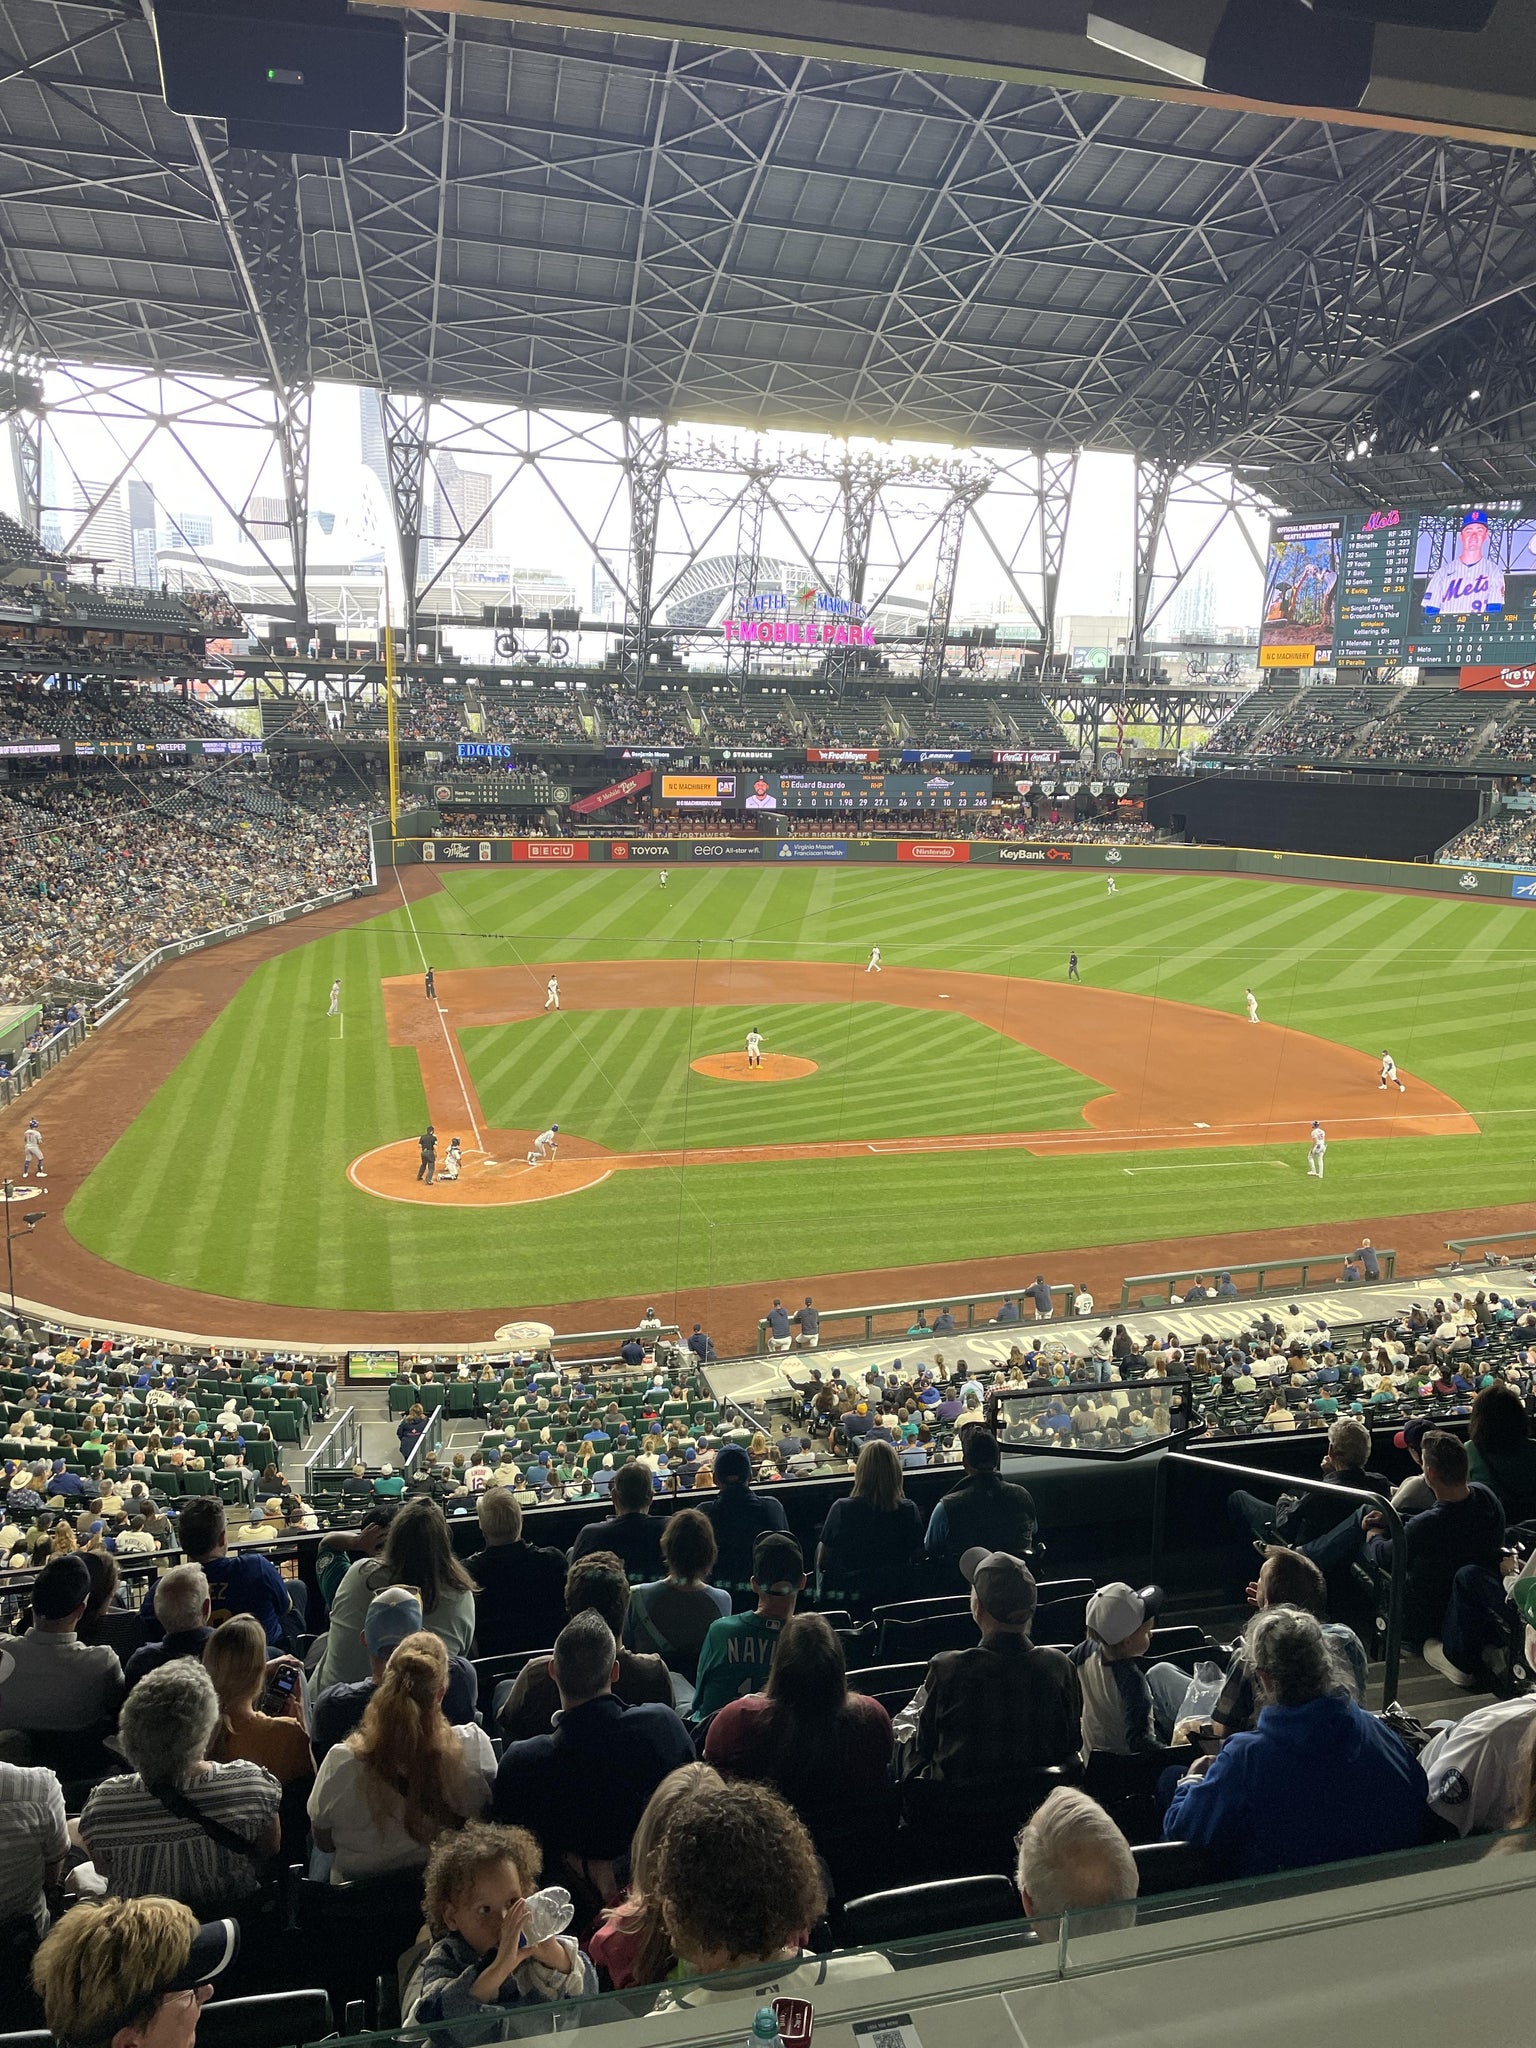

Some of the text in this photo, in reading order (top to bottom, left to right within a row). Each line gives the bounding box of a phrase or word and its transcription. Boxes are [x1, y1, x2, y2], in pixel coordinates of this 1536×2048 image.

[1362, 510, 1400, 531] Mets
[1442, 575, 1488, 602] Mets
[104, 597, 127, 605] Trident
[738, 592, 868, 620] SEATTLE MARINERS
[722, 620, 876, 646] T-MOBILE PARK
[1315, 650, 1332, 662] CAT
[1500, 668, 1535, 680] fire tv
[718, 782, 734, 792] CAT
[532, 847, 570, 856] BECU
[632, 846, 670, 855] TOYOTA
[694, 846, 723, 856] eero
[1000, 850, 1045, 860] KeyBank
[268, 912, 286, 924] STIHL
[472, 1478, 482, 1490] 12
